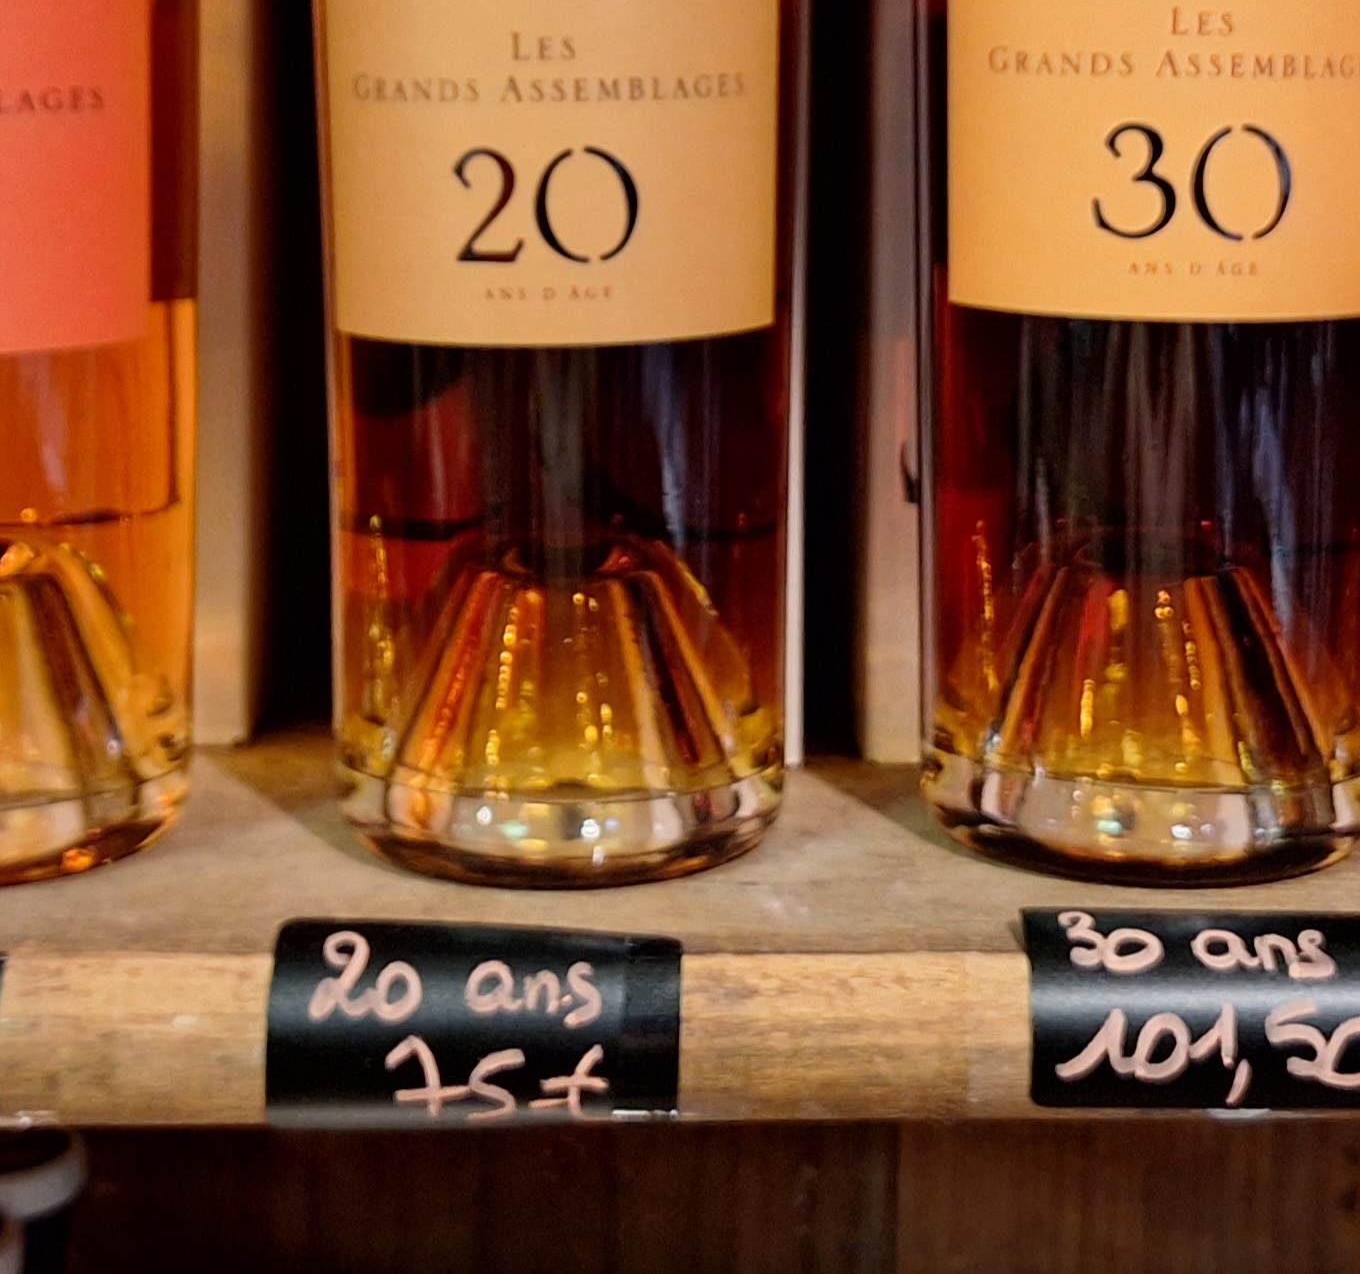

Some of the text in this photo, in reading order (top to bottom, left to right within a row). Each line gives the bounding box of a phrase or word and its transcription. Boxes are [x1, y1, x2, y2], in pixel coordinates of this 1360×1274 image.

[1170, 6, 1236, 37] LES
[511, 32, 576, 62] LES
[988, 46, 1134, 76] GRANDS
[352, 73, 746, 104] GRANDS ASSEMBLAGES
[452, 145, 640, 263] 20
[1092, 122, 1293, 241] 30
[1058, 911, 1336, 980] 30 ans
[308, 930, 603, 1027] 20 ans
